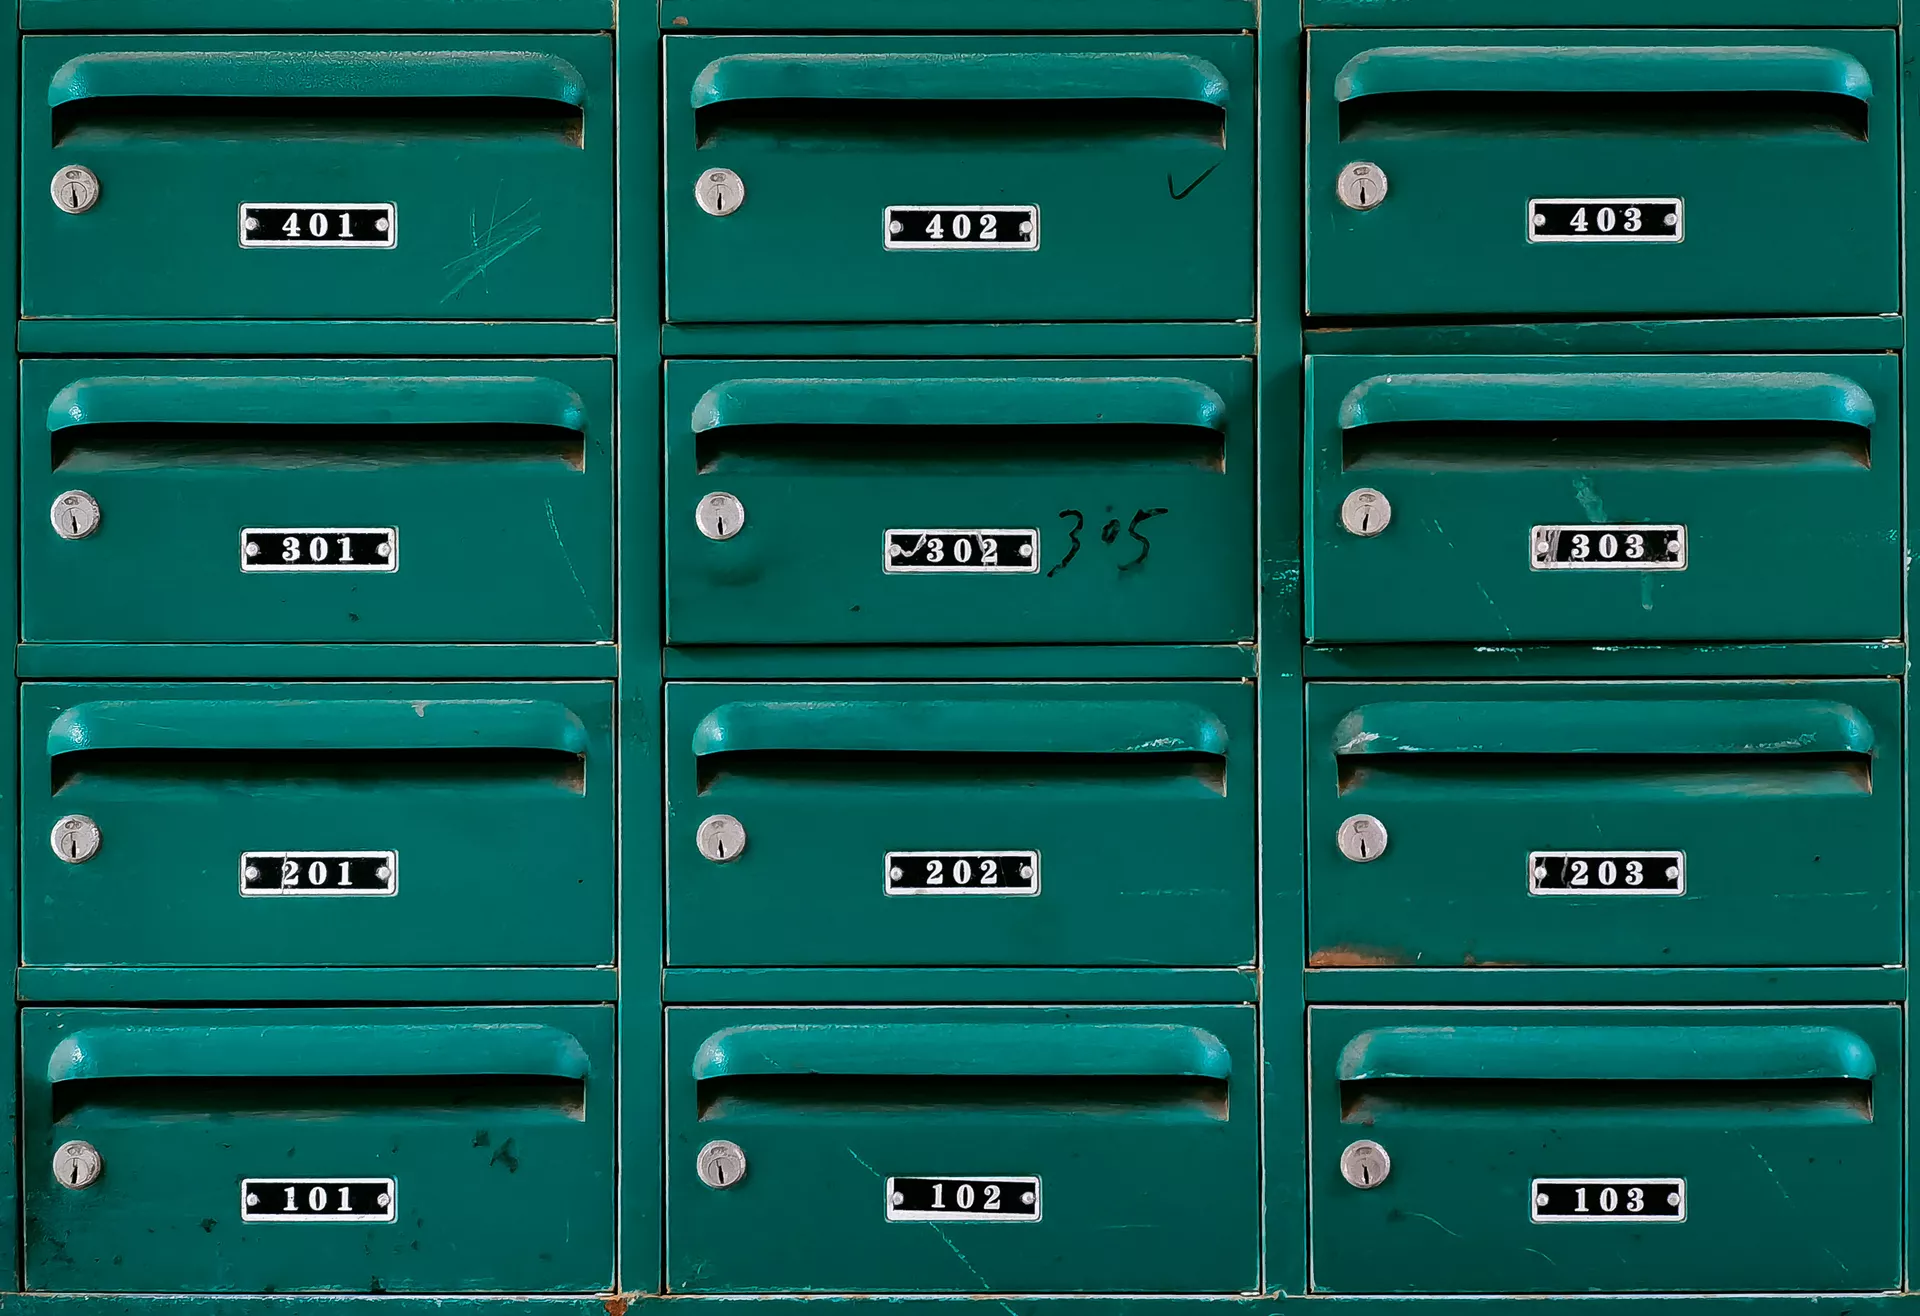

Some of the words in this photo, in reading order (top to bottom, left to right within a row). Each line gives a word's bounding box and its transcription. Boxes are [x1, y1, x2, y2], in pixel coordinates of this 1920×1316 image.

[281, 212, 354, 238] 401
[925, 213, 997, 240] 402
[1569, 206, 1642, 232] 403
[281, 535, 354, 562] 301
[926, 537, 998, 564] 302
[1047, 508, 1169, 578] 305
[1570, 534, 1645, 560] 303
[280, 860, 353, 887] 201
[926, 859, 998, 885] 202
[1570, 860, 1644, 886] 203
[283, 1186, 353, 1212] 101
[931, 1185, 1001, 1210] 102
[1574, 1187, 1645, 1212] 103
